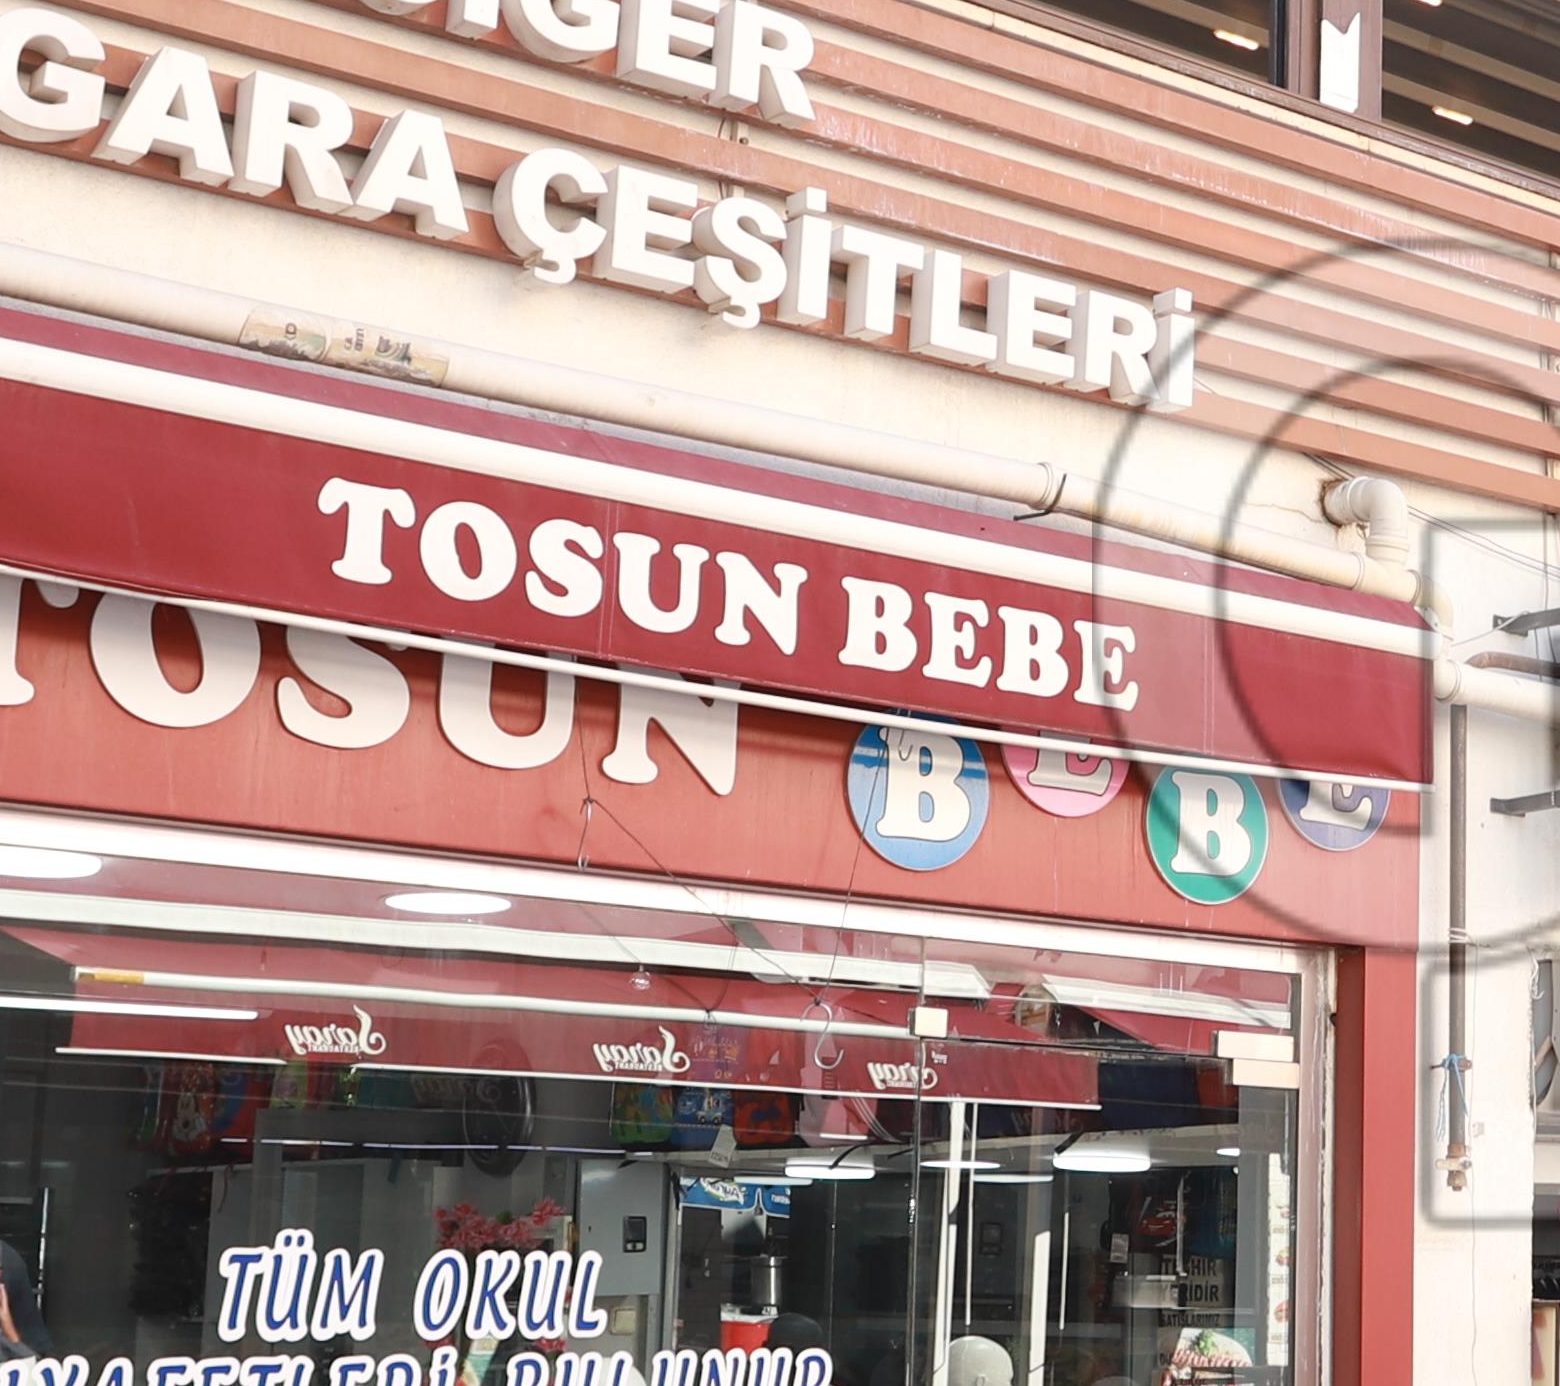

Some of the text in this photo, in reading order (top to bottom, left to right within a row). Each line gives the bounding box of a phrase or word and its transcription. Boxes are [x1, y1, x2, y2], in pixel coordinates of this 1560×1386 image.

[490, 146, 1197, 416] ÇEŞİTLERİ
[318, 474, 1144, 715] TOSUN BEBE
[216, 1227, 609, 1345] TÜM OKUL
